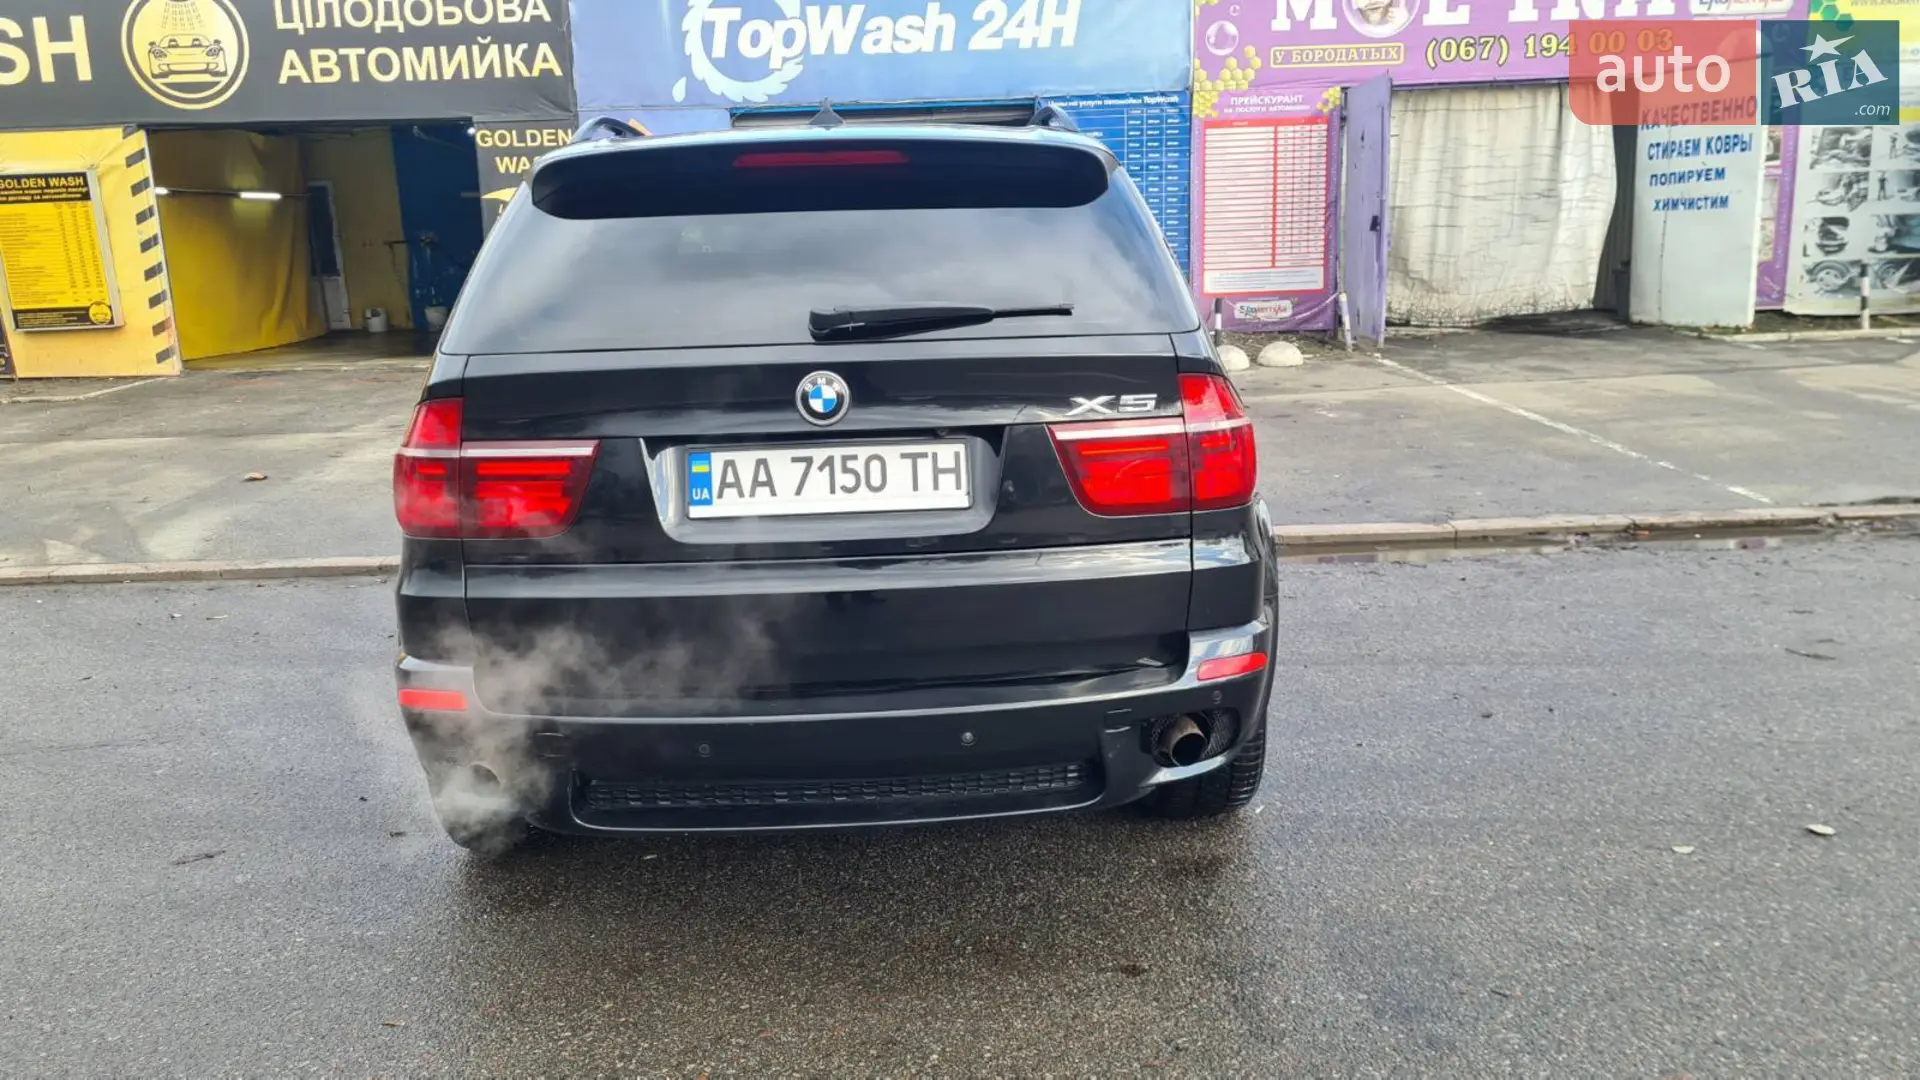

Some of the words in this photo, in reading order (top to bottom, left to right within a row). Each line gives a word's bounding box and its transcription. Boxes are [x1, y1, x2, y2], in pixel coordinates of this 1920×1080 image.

[274, 0, 552, 35] ЦІЛОДОБОВА
[703, 2, 956, 69] TopWash
[967, 0, 1082, 51] 24H
[1426, 36, 1510, 69] (067)
[1524, 32, 1577, 59] 194
[1589, 30, 1626, 54] 00
[1637, 28, 1674, 52] 03
[278, 35, 564, 84] АВТОМИЙКА
[1291, 47, 1399, 64] БОРОДАТЫХ
[1640, 95, 1758, 131] КАЧЕСТВЕННО
[476, 128, 572, 148] GOLDEN
[1647, 138, 1702, 161] СТИРАЕМ
[1705, 132, 1753, 155] КОВРЫ
[48, 176, 84, 187] WASH
[1653, 195, 1729, 212] ХИМЧИСТИМ
[1064, 393, 1158, 416] X5
[716, 457, 777, 500] AA
[790, 453, 888, 497] 7150
[900, 450, 963, 493] TH
[692, 487, 710, 501] UA
